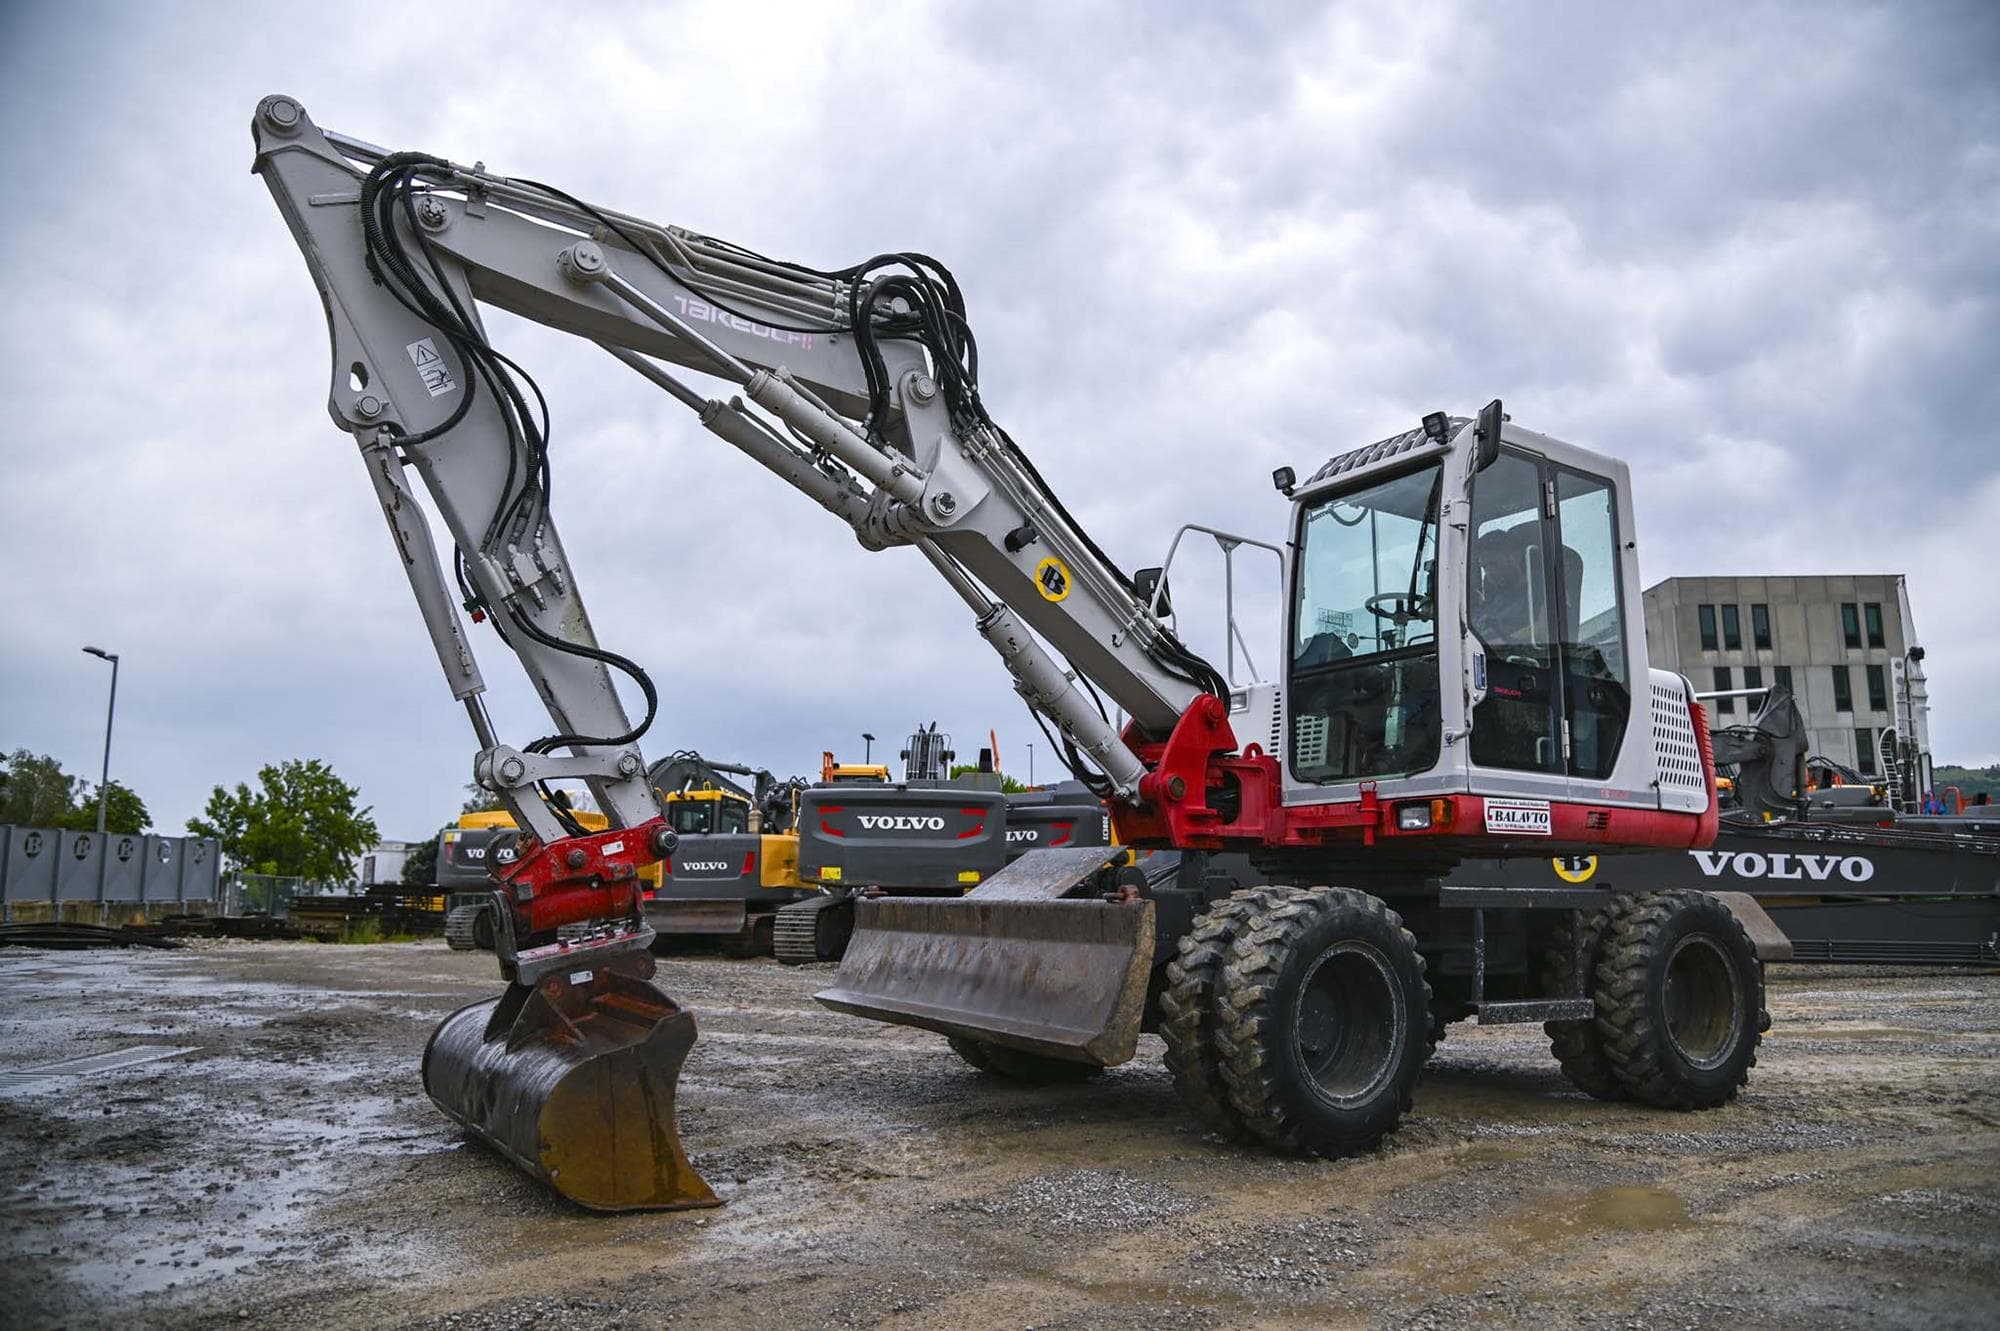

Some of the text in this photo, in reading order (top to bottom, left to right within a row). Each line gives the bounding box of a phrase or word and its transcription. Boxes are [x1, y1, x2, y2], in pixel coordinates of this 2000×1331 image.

[1039, 563, 1066, 595] B
[857, 815, 945, 830] VOLVO
[1495, 810, 1549, 824] BALAVTO
[1005, 830, 1038, 841] LVO
[466, 848, 514, 858] VOO
[682, 861, 728, 871] VOLVO
[1688, 850, 1874, 882] VOLVO
